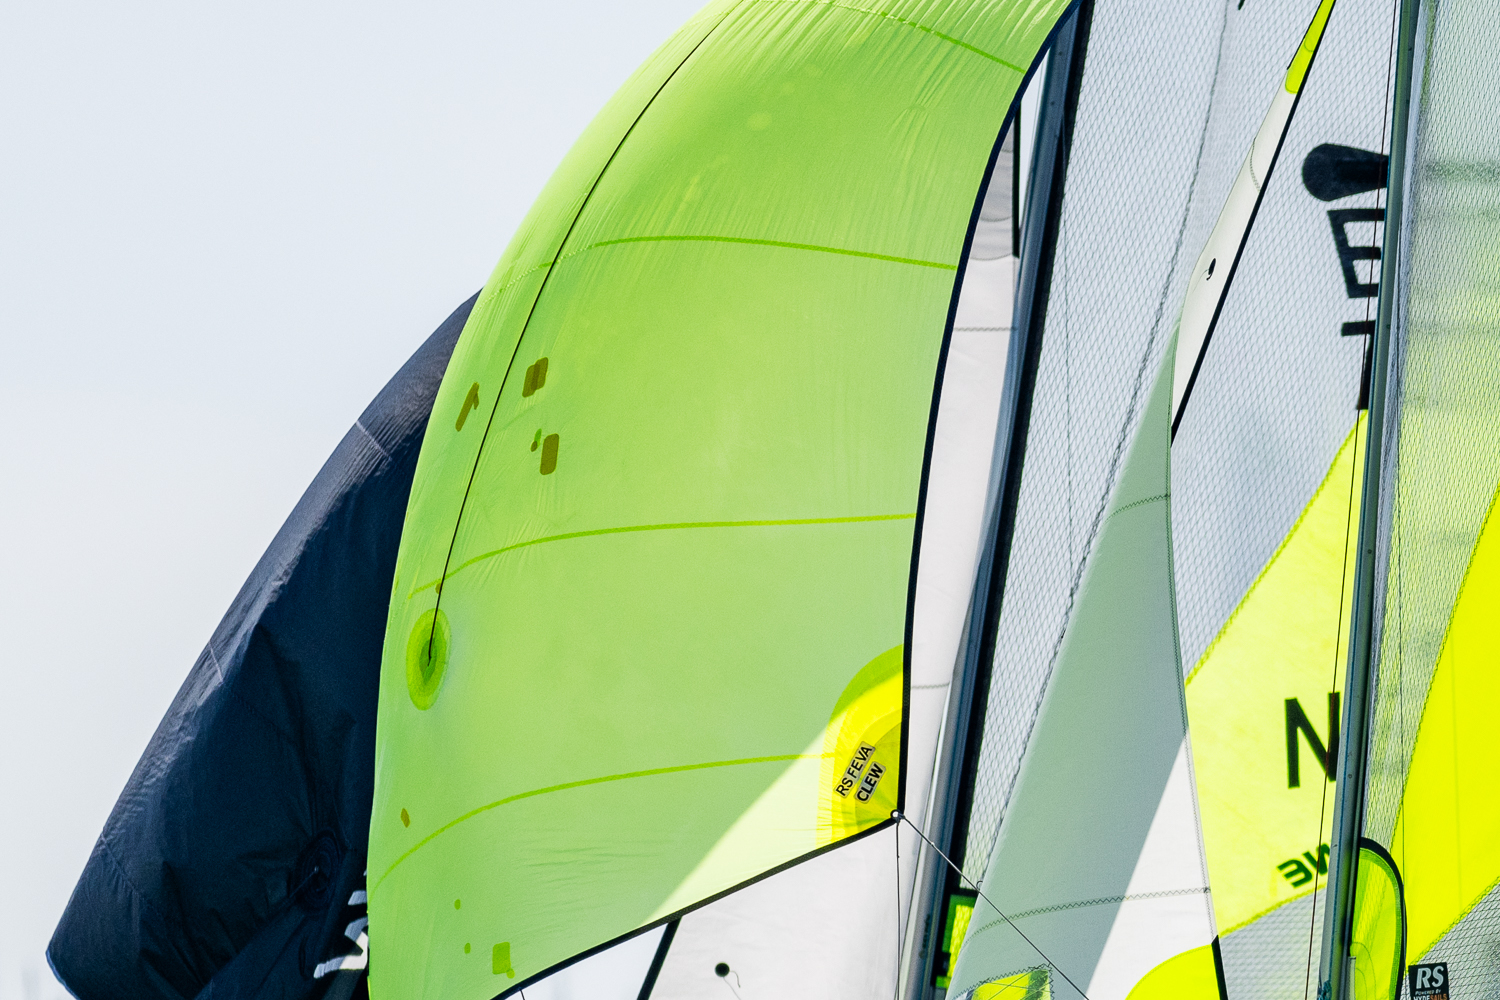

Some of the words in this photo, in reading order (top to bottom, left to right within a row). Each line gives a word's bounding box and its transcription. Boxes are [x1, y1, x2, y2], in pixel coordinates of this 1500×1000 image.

[835, 777, 853, 797] RS
[847, 746, 873, 779] FEVA
[856, 763, 884, 802] CLEW
[1415, 965, 1445, 989] RS
